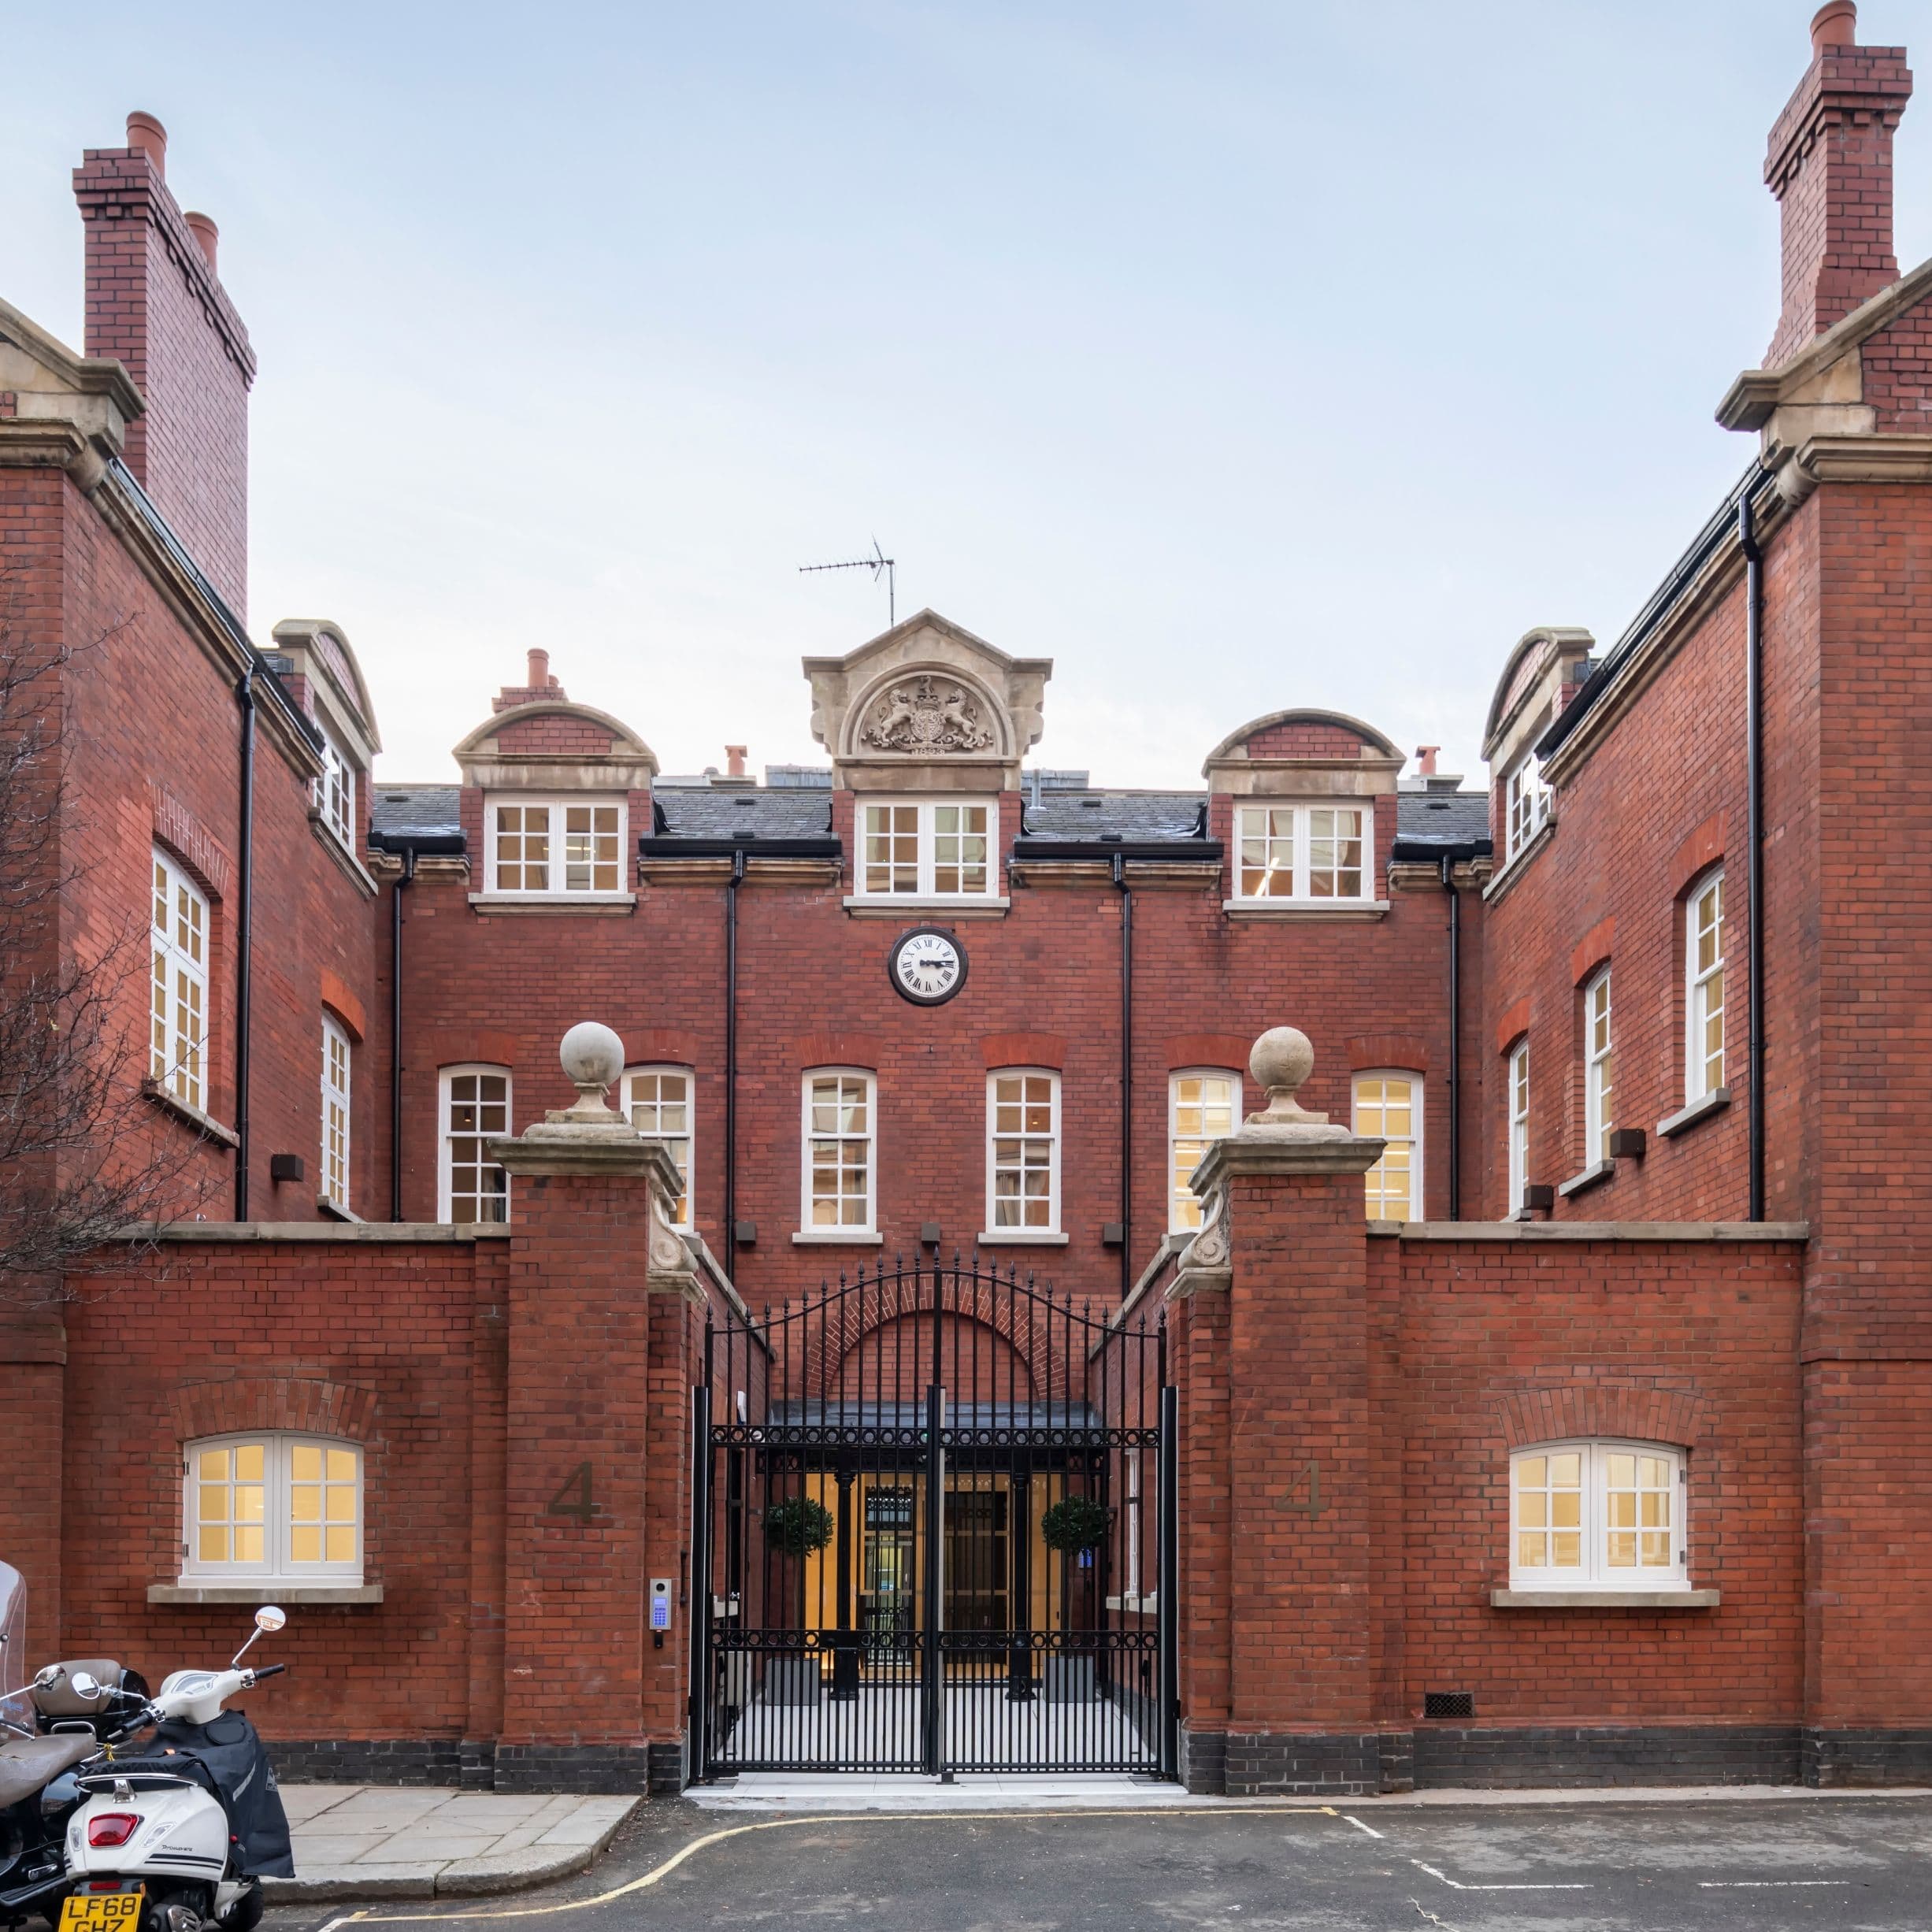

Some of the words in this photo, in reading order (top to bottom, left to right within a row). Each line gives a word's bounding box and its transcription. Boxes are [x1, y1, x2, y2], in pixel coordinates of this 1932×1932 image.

[924, 939, 933, 947] XII
[547, 1461, 601, 1524] 4
[1275, 1460, 1329, 1521] 4
[68, 1897, 136, 1919] LF68
